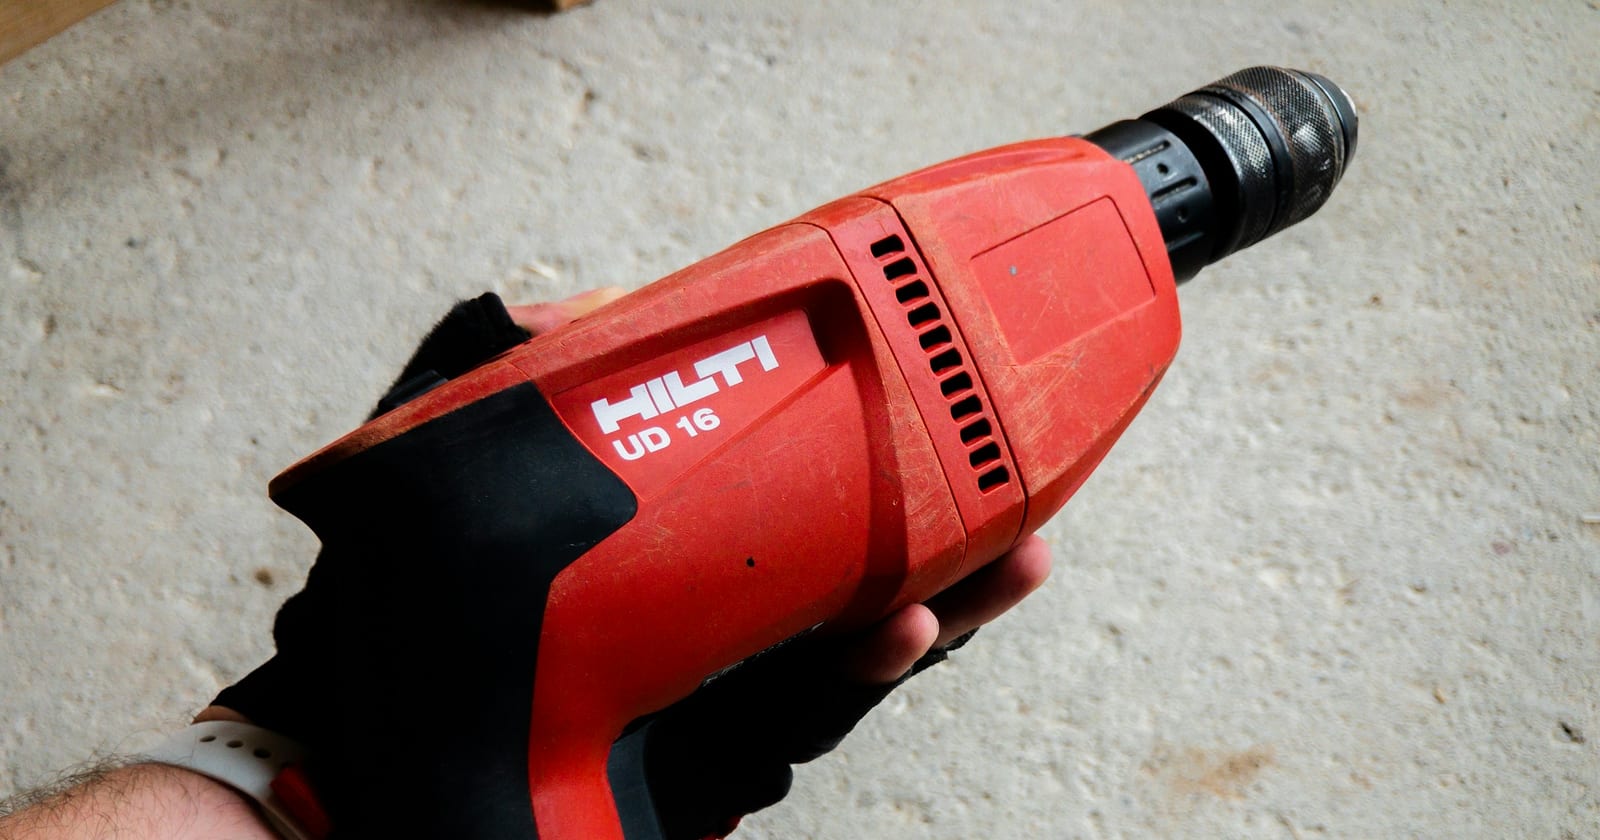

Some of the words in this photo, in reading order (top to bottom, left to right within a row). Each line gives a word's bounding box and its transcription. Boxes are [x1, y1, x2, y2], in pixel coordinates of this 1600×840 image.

[591, 335, 779, 434] HILTI
[612, 426, 671, 460] UD
[676, 408, 721, 437] 16
